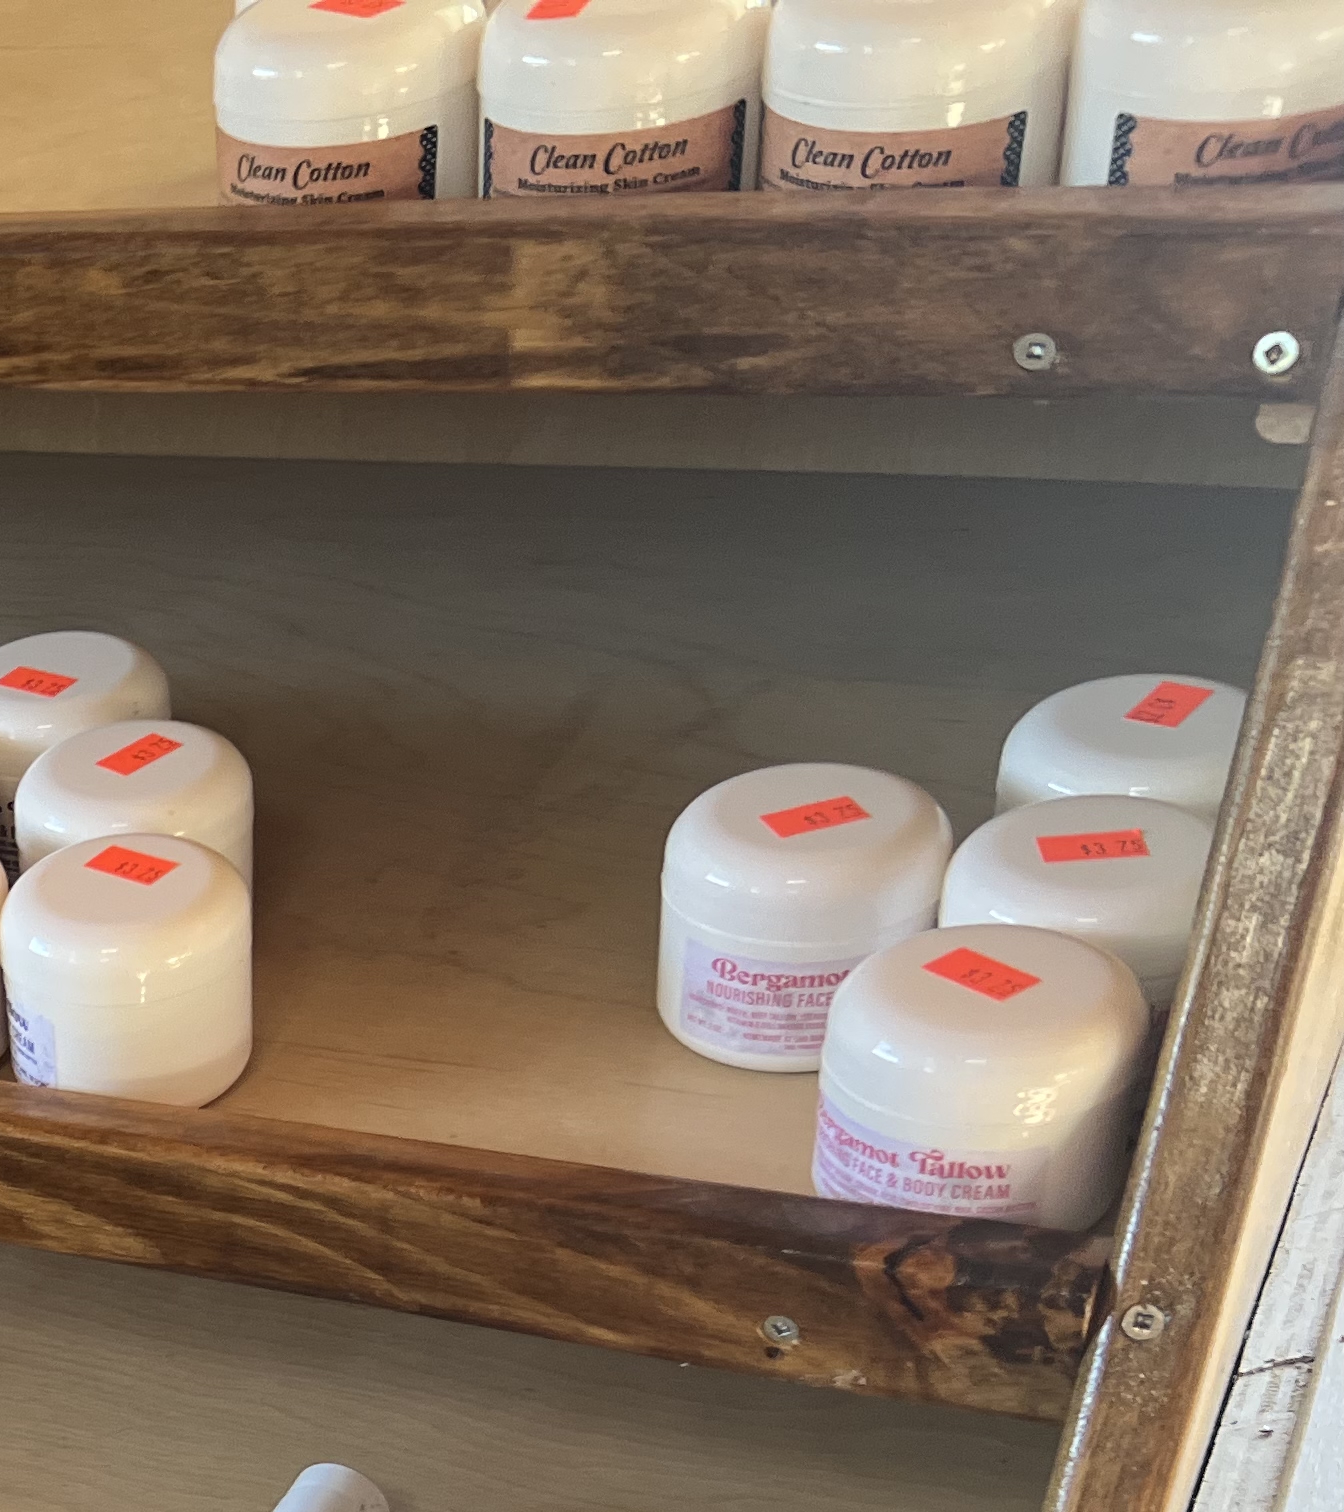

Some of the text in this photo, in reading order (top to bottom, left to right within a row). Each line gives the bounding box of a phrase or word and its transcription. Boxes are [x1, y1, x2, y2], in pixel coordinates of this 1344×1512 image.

[237, 153, 372, 190] Clean Cotton
[529, 137, 689, 175] Clean Cotton
[792, 137, 952, 180] Clean Cotton
[614, 176, 648, 191] Skin
[706, 980, 793, 1008] NOURISHING
[909, 1149, 1011, 1180] Tallow
[903, 1177, 947, 1198] BODY
[950, 1184, 1011, 1200] CREAM
